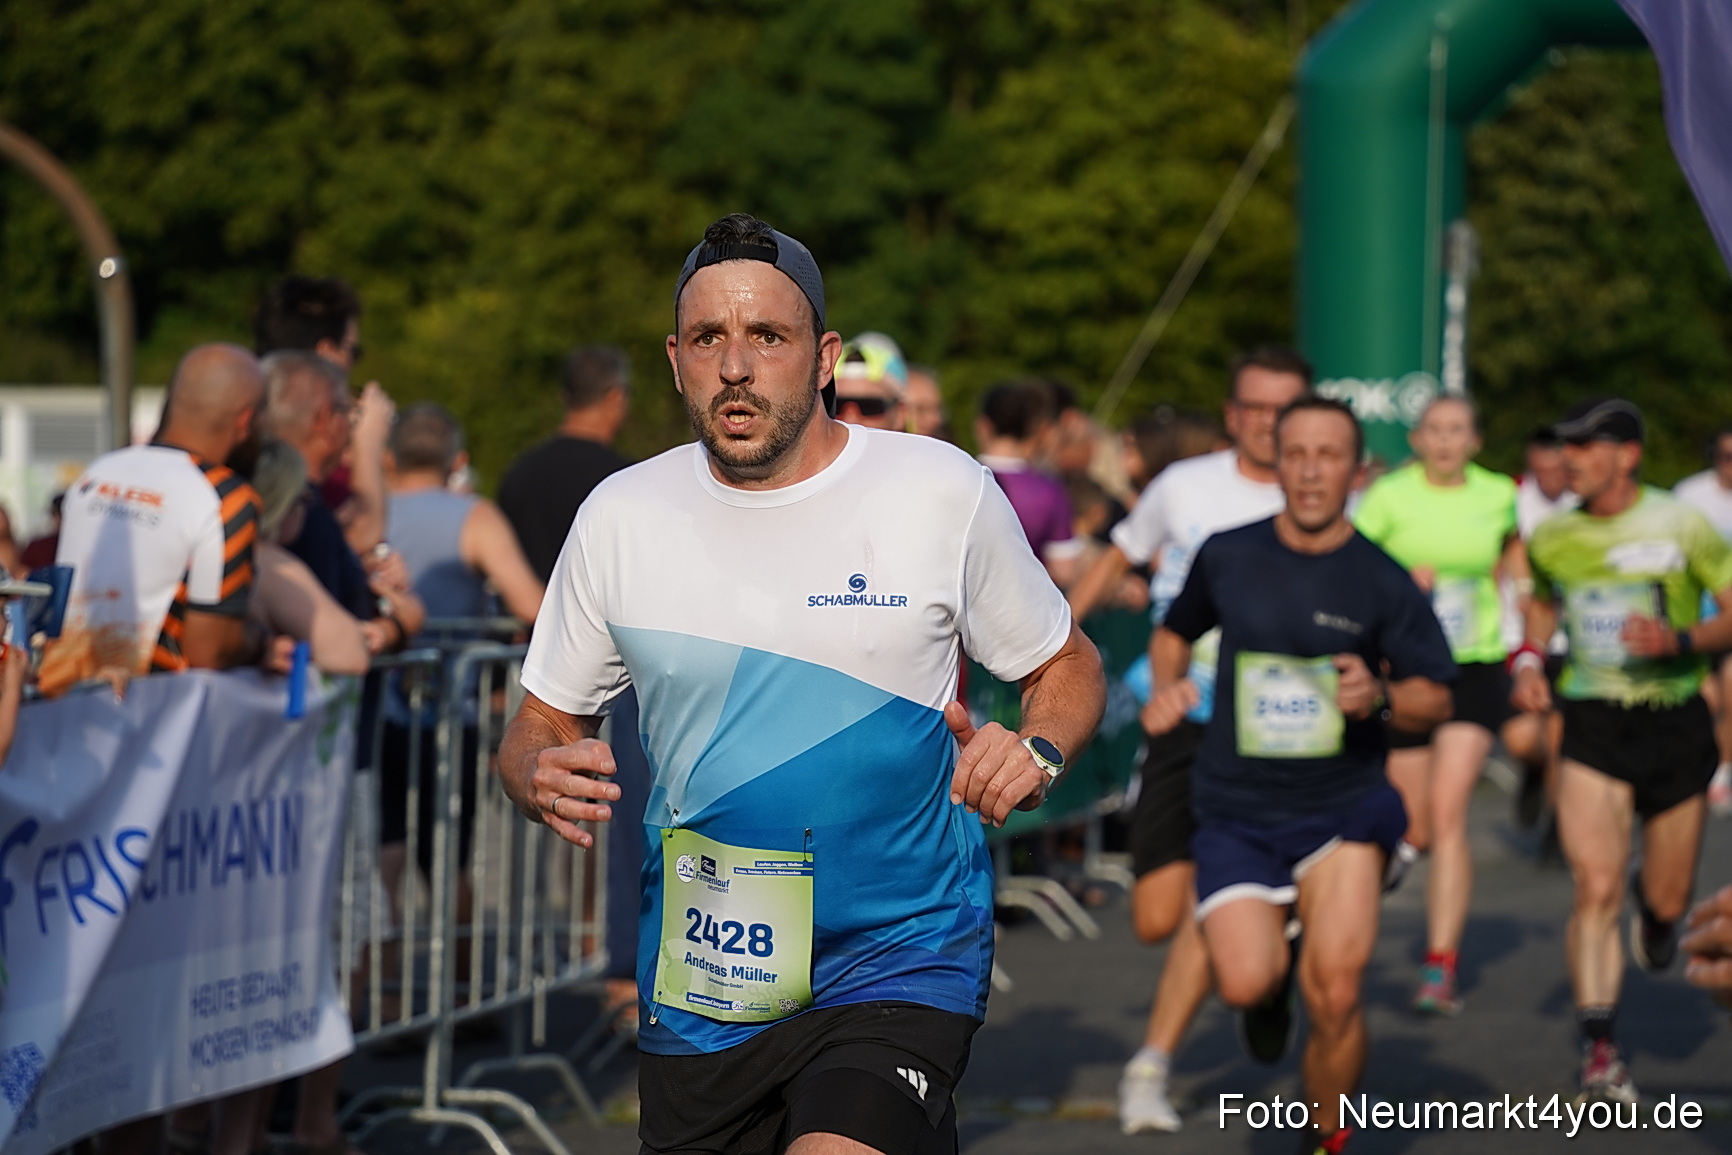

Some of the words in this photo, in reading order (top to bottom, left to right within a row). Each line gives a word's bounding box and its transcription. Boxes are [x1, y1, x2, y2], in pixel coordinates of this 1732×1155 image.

[807, 594, 908, 608] SCHABMÜLLER
[695, 870, 730, 888] Firmenlauf
[685, 907, 774, 958] 2428
[684, 951, 727, 978] Andreas
[731, 965, 777, 984] Müller
